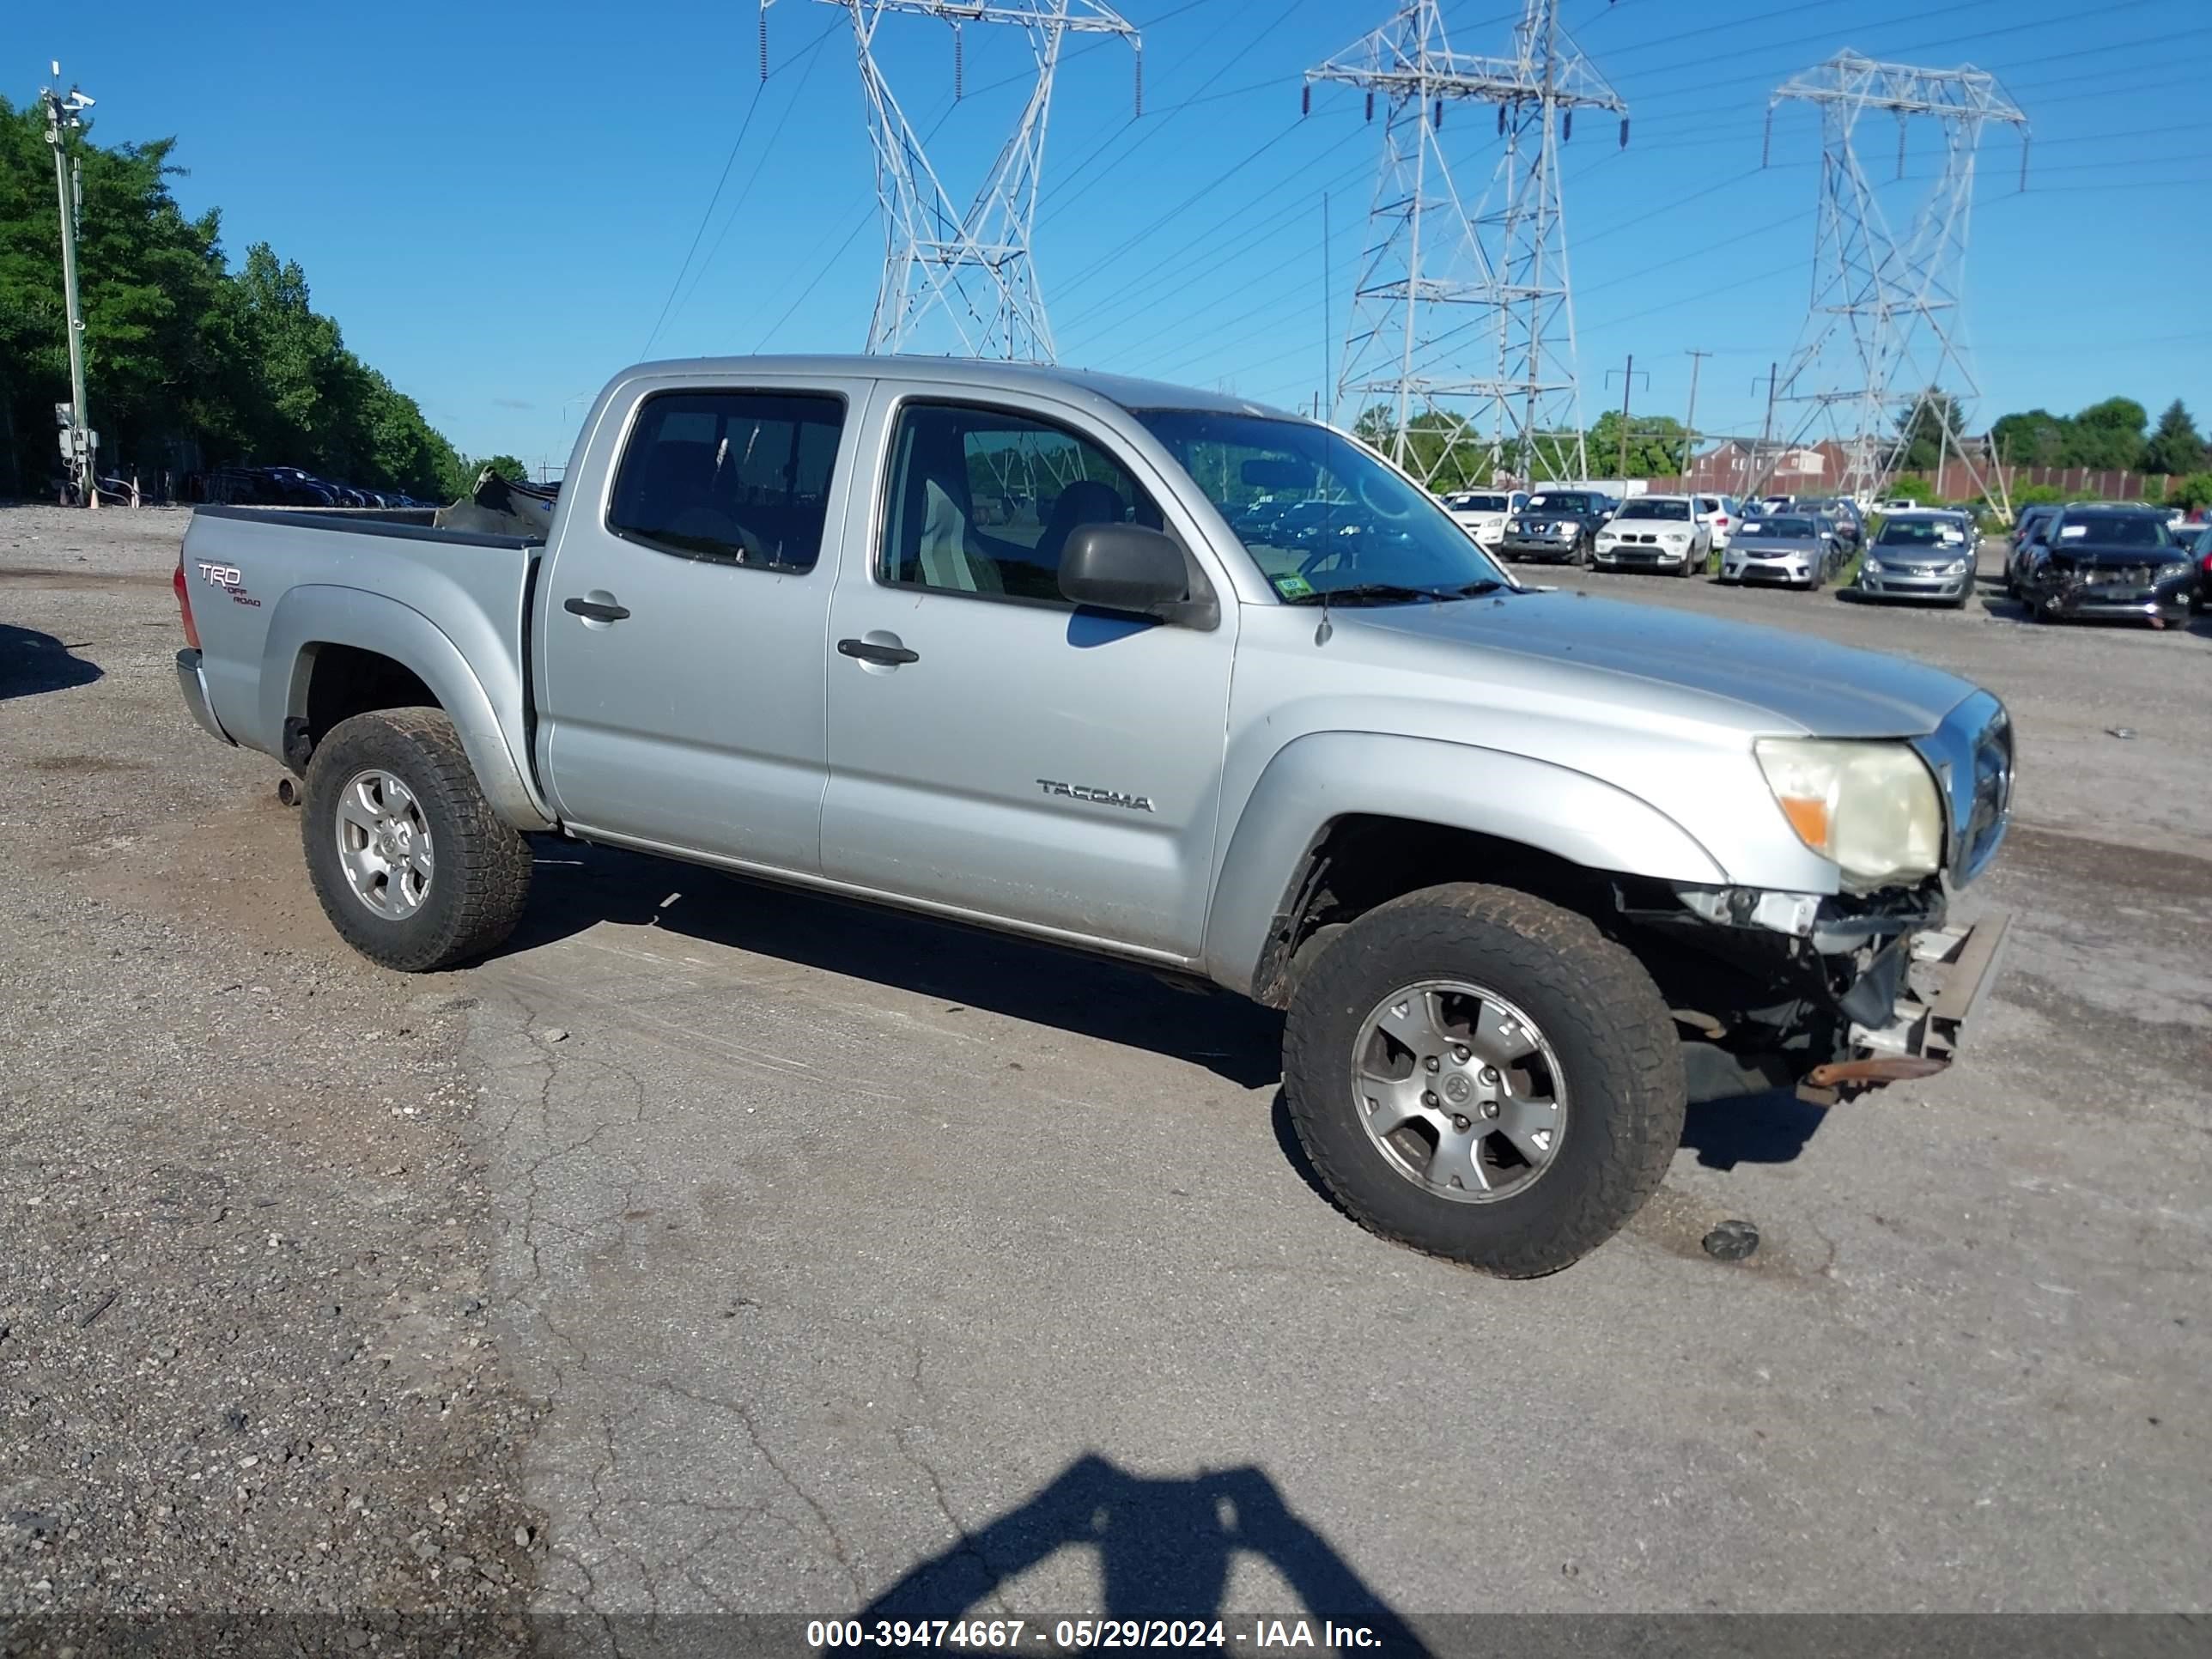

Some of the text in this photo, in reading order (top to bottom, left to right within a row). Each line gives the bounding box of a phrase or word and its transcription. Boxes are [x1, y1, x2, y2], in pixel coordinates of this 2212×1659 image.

[198, 563, 241, 589] TRD
[227, 586, 247, 596] OFF
[233, 596, 261, 608] ROAD
[1036, 779, 1156, 812] TACOMA
